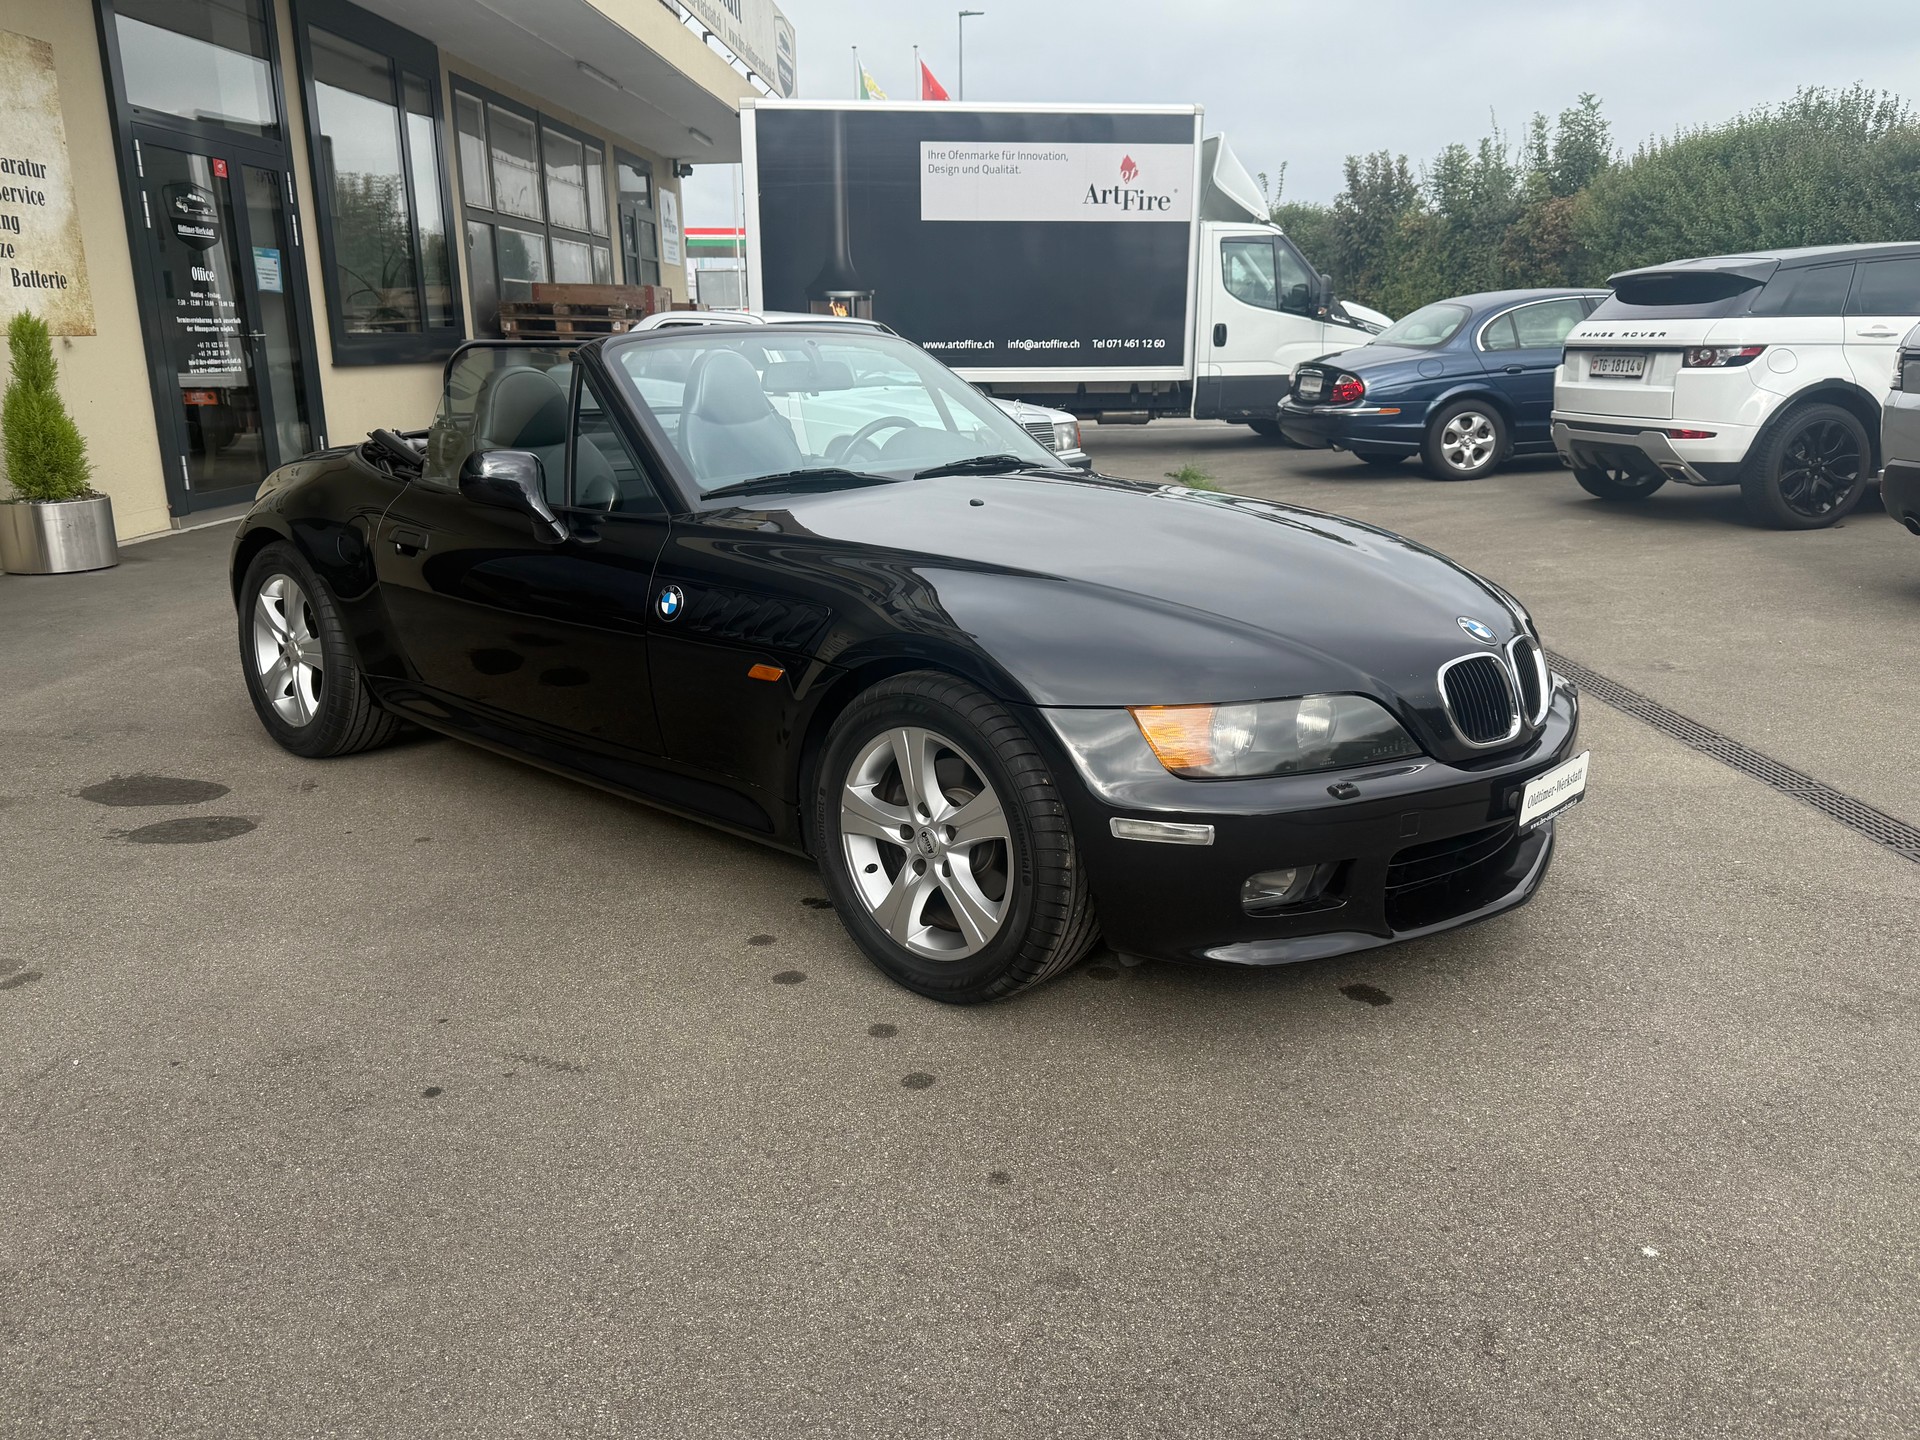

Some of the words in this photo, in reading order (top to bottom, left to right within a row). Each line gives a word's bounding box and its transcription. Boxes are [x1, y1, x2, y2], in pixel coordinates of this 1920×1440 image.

[927, 149, 946, 161] Ihre
[948, 150, 1000, 161] Ofenmarke
[1002, 150, 1016, 161] für
[1017, 151, 1069, 162] Innovation,
[0, 157, 47, 179] aratur
[928, 164, 960, 177] Design
[962, 164, 980, 175] und
[982, 165, 1022, 176] Qualität.
[0, 185, 46, 207] ervice
[10, 267, 68, 290] Batterie
[191, 266, 215, 281] Office
[923, 339, 995, 350] www.artoffire.ch
[1007, 338, 1081, 350] info@artoffire.ch
[1092, 339, 1105, 349] Tel
[1106, 339, 1122, 349] 071
[1124, 339, 1140, 348] 461
[1142, 339, 1152, 348] 12
[1154, 339, 1166, 348] 60
[1527, 768, 1583, 809] Oldtimer-Werkstatt
